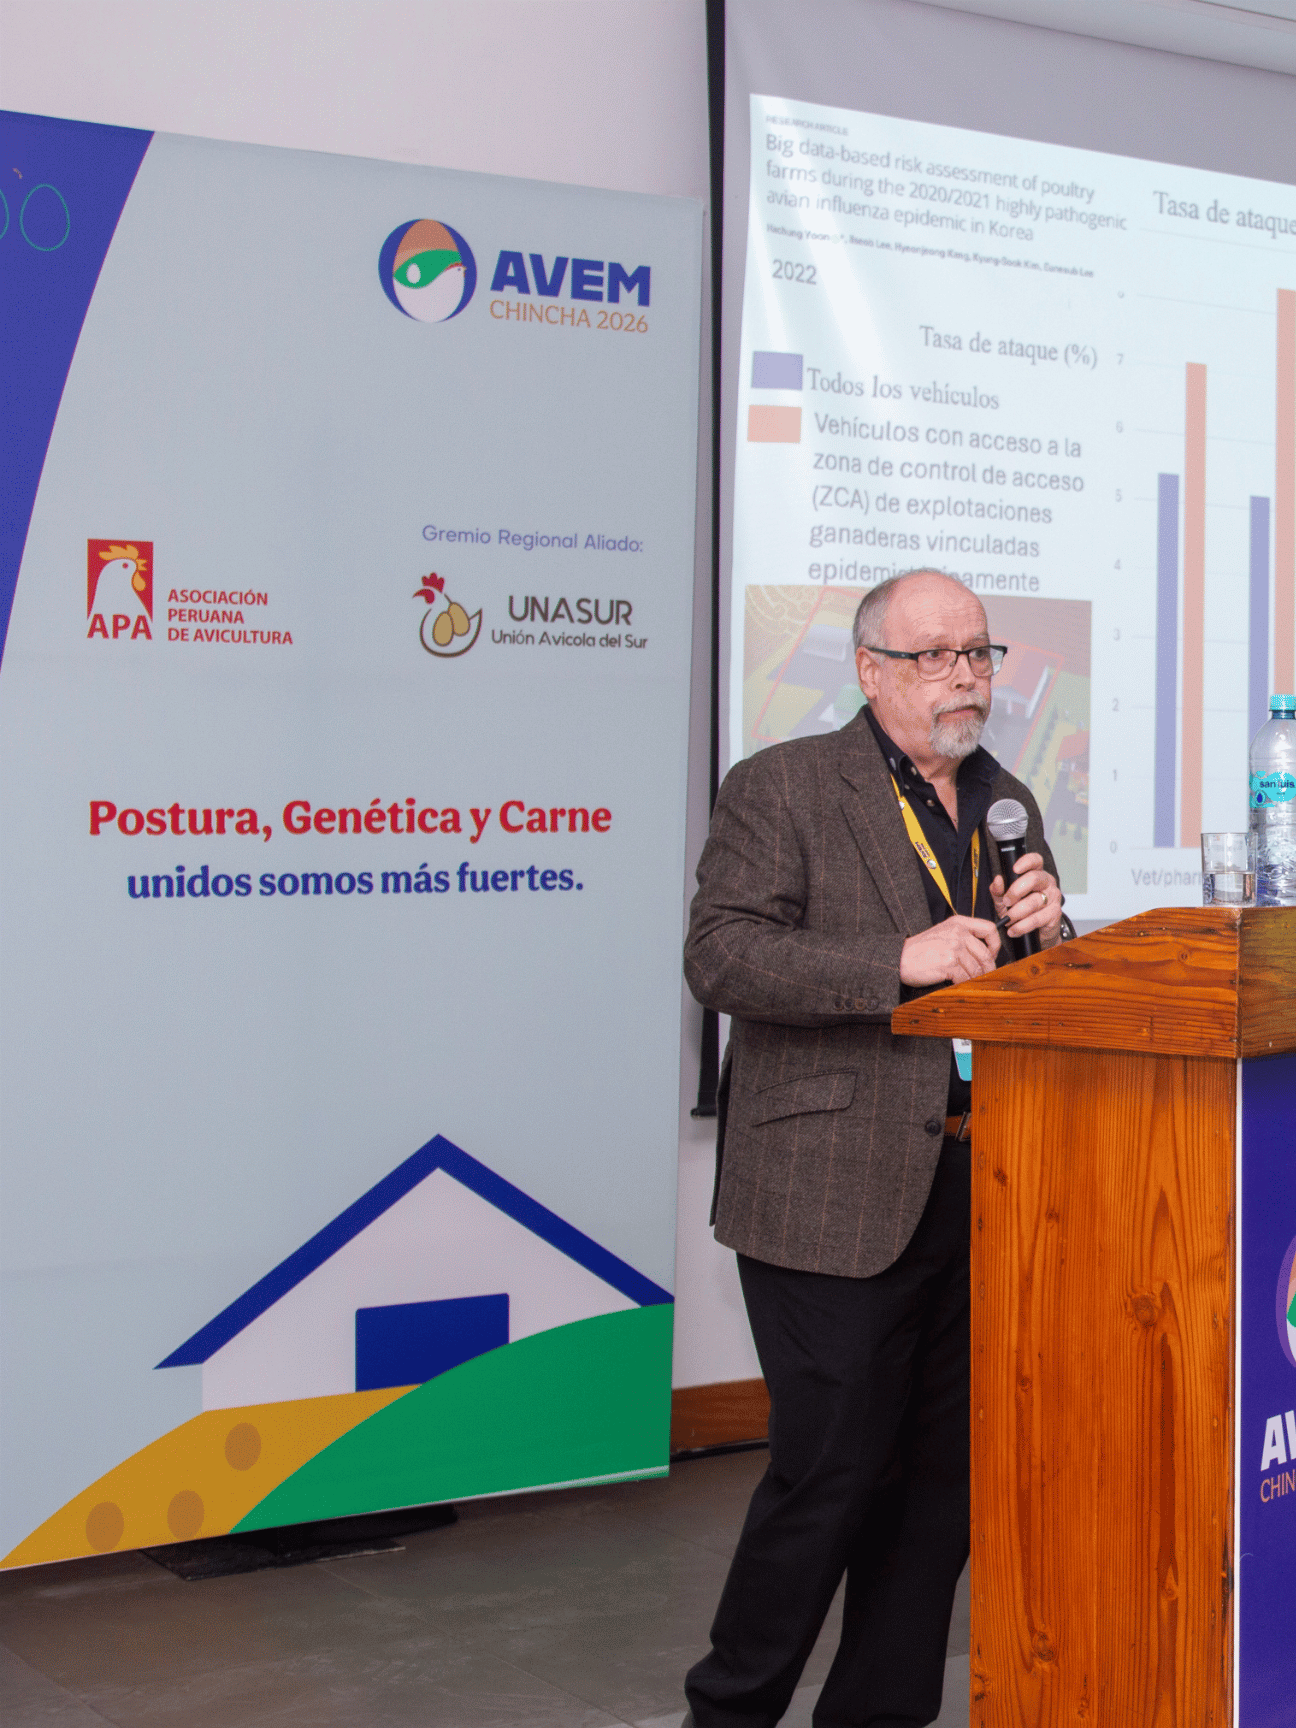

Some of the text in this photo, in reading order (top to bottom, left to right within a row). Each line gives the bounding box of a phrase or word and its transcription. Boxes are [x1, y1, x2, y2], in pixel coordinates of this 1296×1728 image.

[766, 133, 1095, 203] Big data-based risk assessment of poultry
[766, 159, 1128, 232] farms during the 2020/2021 highly pathogenic
[1153, 190, 1200, 221] Tasa
[1206, 199, 1230, 225] de
[766, 189, 1034, 242] avian influenza epidemic in Korea
[490, 249, 651, 307] AVEM
[772, 258, 817, 285] 2022
[489, 299, 649, 334] CHINCHA 2026
[919, 325, 1098, 370] Tasa de ataque (%)
[1116, 352, 1125, 366] 7
[807, 367, 999, 410] Todos los vehículos
[814, 412, 1082, 458] Vehículos con acceso a la
[1115, 420, 1124, 434] 6
[813, 452, 1085, 492] zona de control de acceso
[812, 485, 1053, 525] (ZCA) de explotaciones
[1114, 488, 1123, 503] 5
[422, 524, 643, 554] Gremio Regional Aliado:
[809, 523, 1040, 557] ganaderas vinculadas
[1113, 559, 1121, 571] 4
[168, 588, 268, 607] ASOCIACIÓN
[508, 595, 633, 626] UNASUR
[87, 612, 153, 641] APA
[168, 608, 245, 625] PERUANA
[168, 627, 293, 646] DE AVICULTURA
[491, 628, 535, 647] Unión
[599, 632, 622, 648] del
[624, 633, 648, 649] Sur
[1112, 628, 1121, 641] 3
[1111, 698, 1120, 712] 2
[1112, 769, 1118, 782] 1
[89, 797, 612, 844] Postura, Genética y Carne
[1109, 841, 1118, 854] 0
[127, 862, 583, 898] unidos somos más fuertes.
